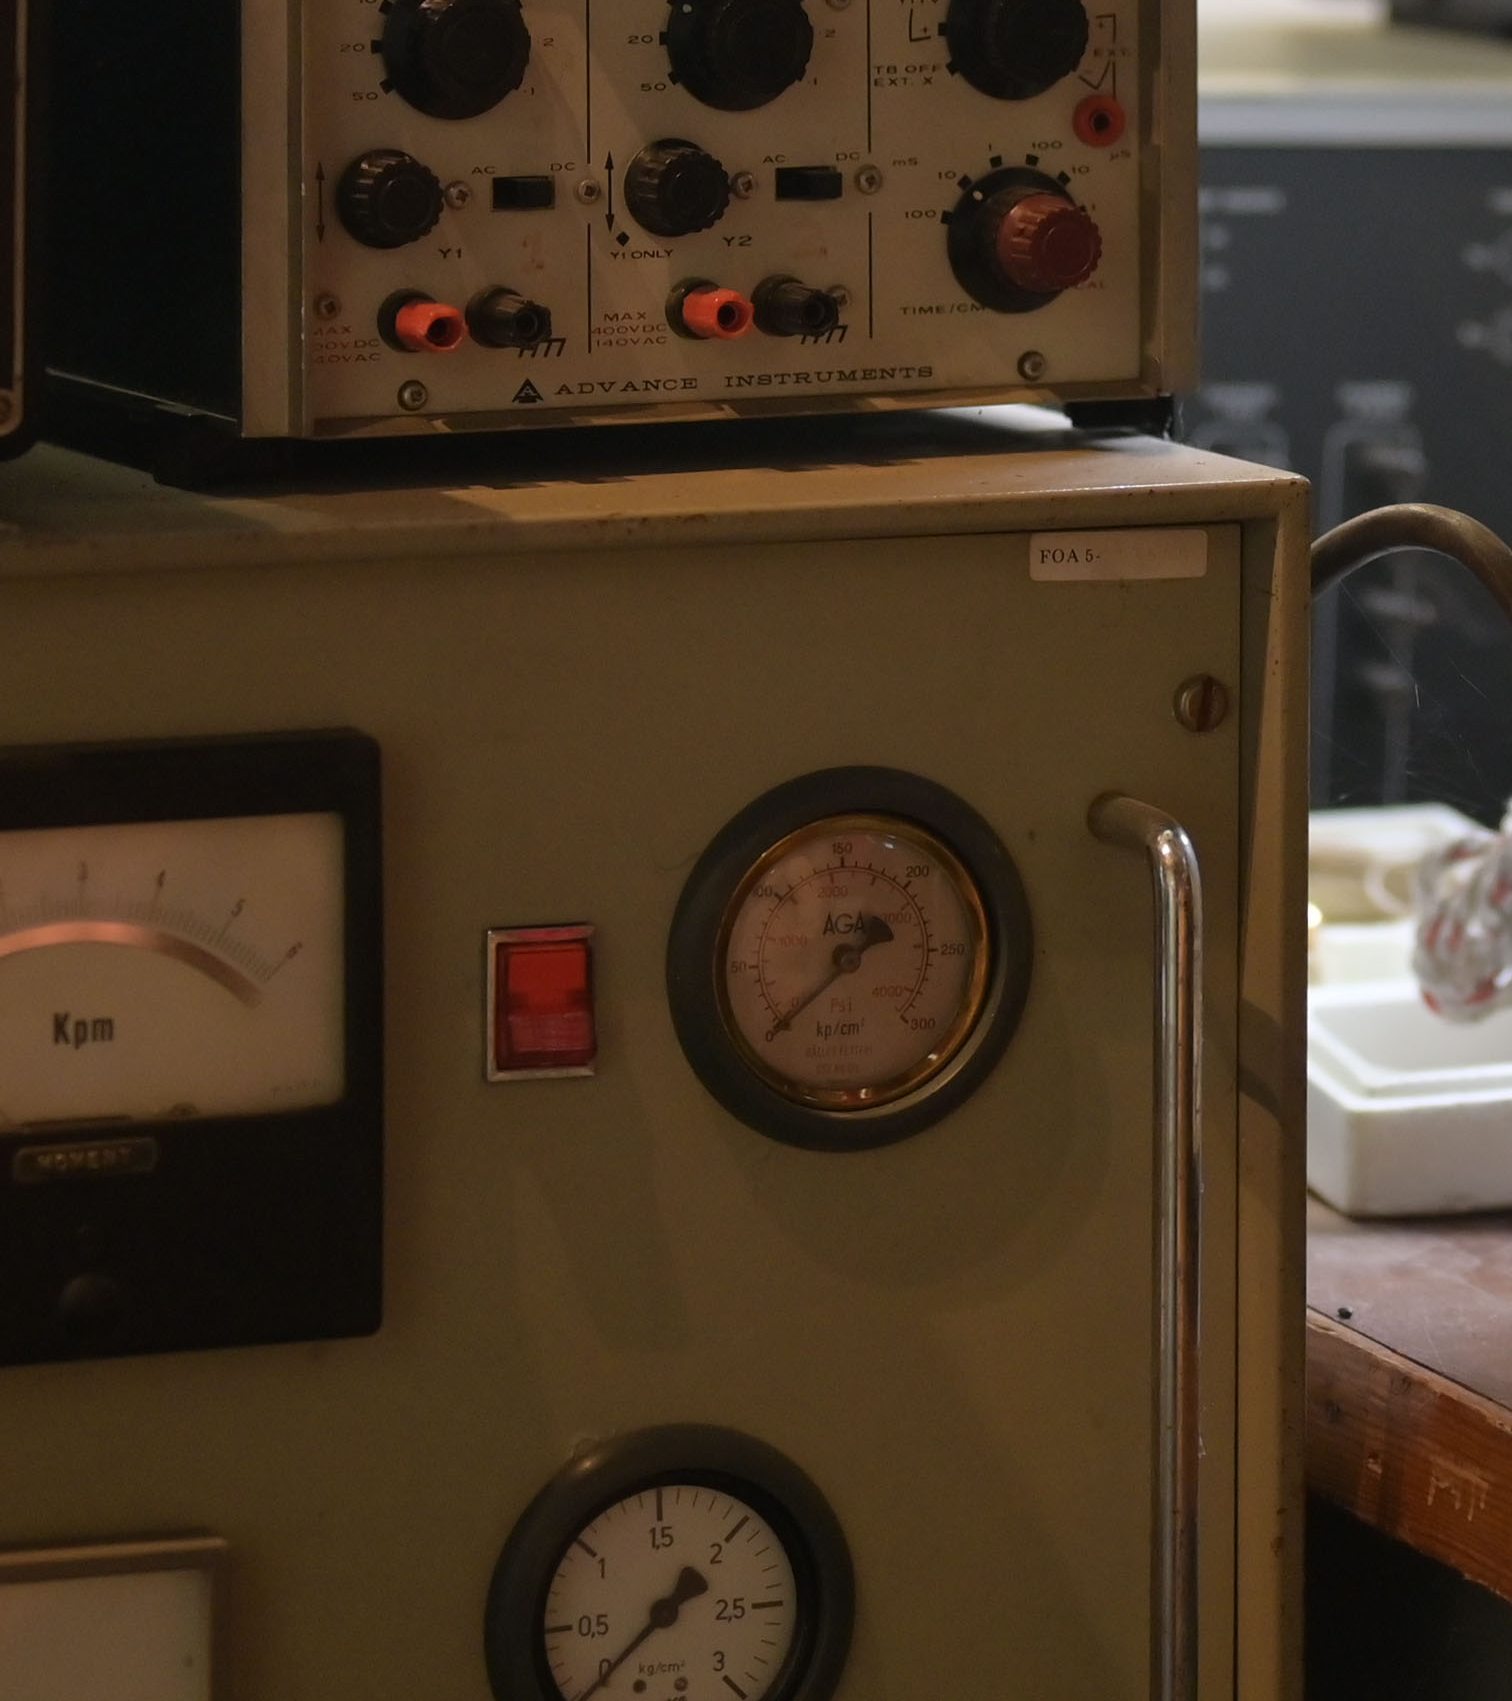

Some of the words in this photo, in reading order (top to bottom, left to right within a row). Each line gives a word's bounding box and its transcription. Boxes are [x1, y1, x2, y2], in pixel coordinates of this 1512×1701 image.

[627, 34, 654, 45] 20
[340, 42, 365, 52] 20
[640, 81, 667, 93] 50
[922, 75, 934, 86] X
[351, 90, 379, 101] 50
[1031, 139, 1063, 151] 100
[763, 153, 786, 163] AC
[471, 165, 496, 175] AC
[550, 161, 575, 171] DC
[937, 169, 957, 180] 10
[1071, 163, 1090, 174] 10
[904, 208, 937, 220] 100
[722, 234, 753, 247] Y2
[437, 247, 463, 259] Y1
[610, 250, 627, 260] Y1
[631, 248, 674, 260] ONLY
[603, 311, 647, 321] MAX
[554, 378, 698, 396] ADVANCE
[724, 365, 934, 389] INSTRUMENTS
[1040, 548, 1079, 564] FOA
[832, 841, 853, 855] 150
[906, 865, 930, 878] 200
[822, 912, 865, 936] AGA
[940, 943, 965, 956] 250
[731, 960, 747, 974] 50
[910, 1017, 936, 1030] 300
[53, 1013, 115, 1048] Kpm
[709, 1543, 723, 1564] 2
[597, 1558, 607, 1579] 1
[714, 1598, 747, 1623] 2,5
[577, 1614, 609, 1639] 0,5
[712, 1650, 726, 1672] 3
